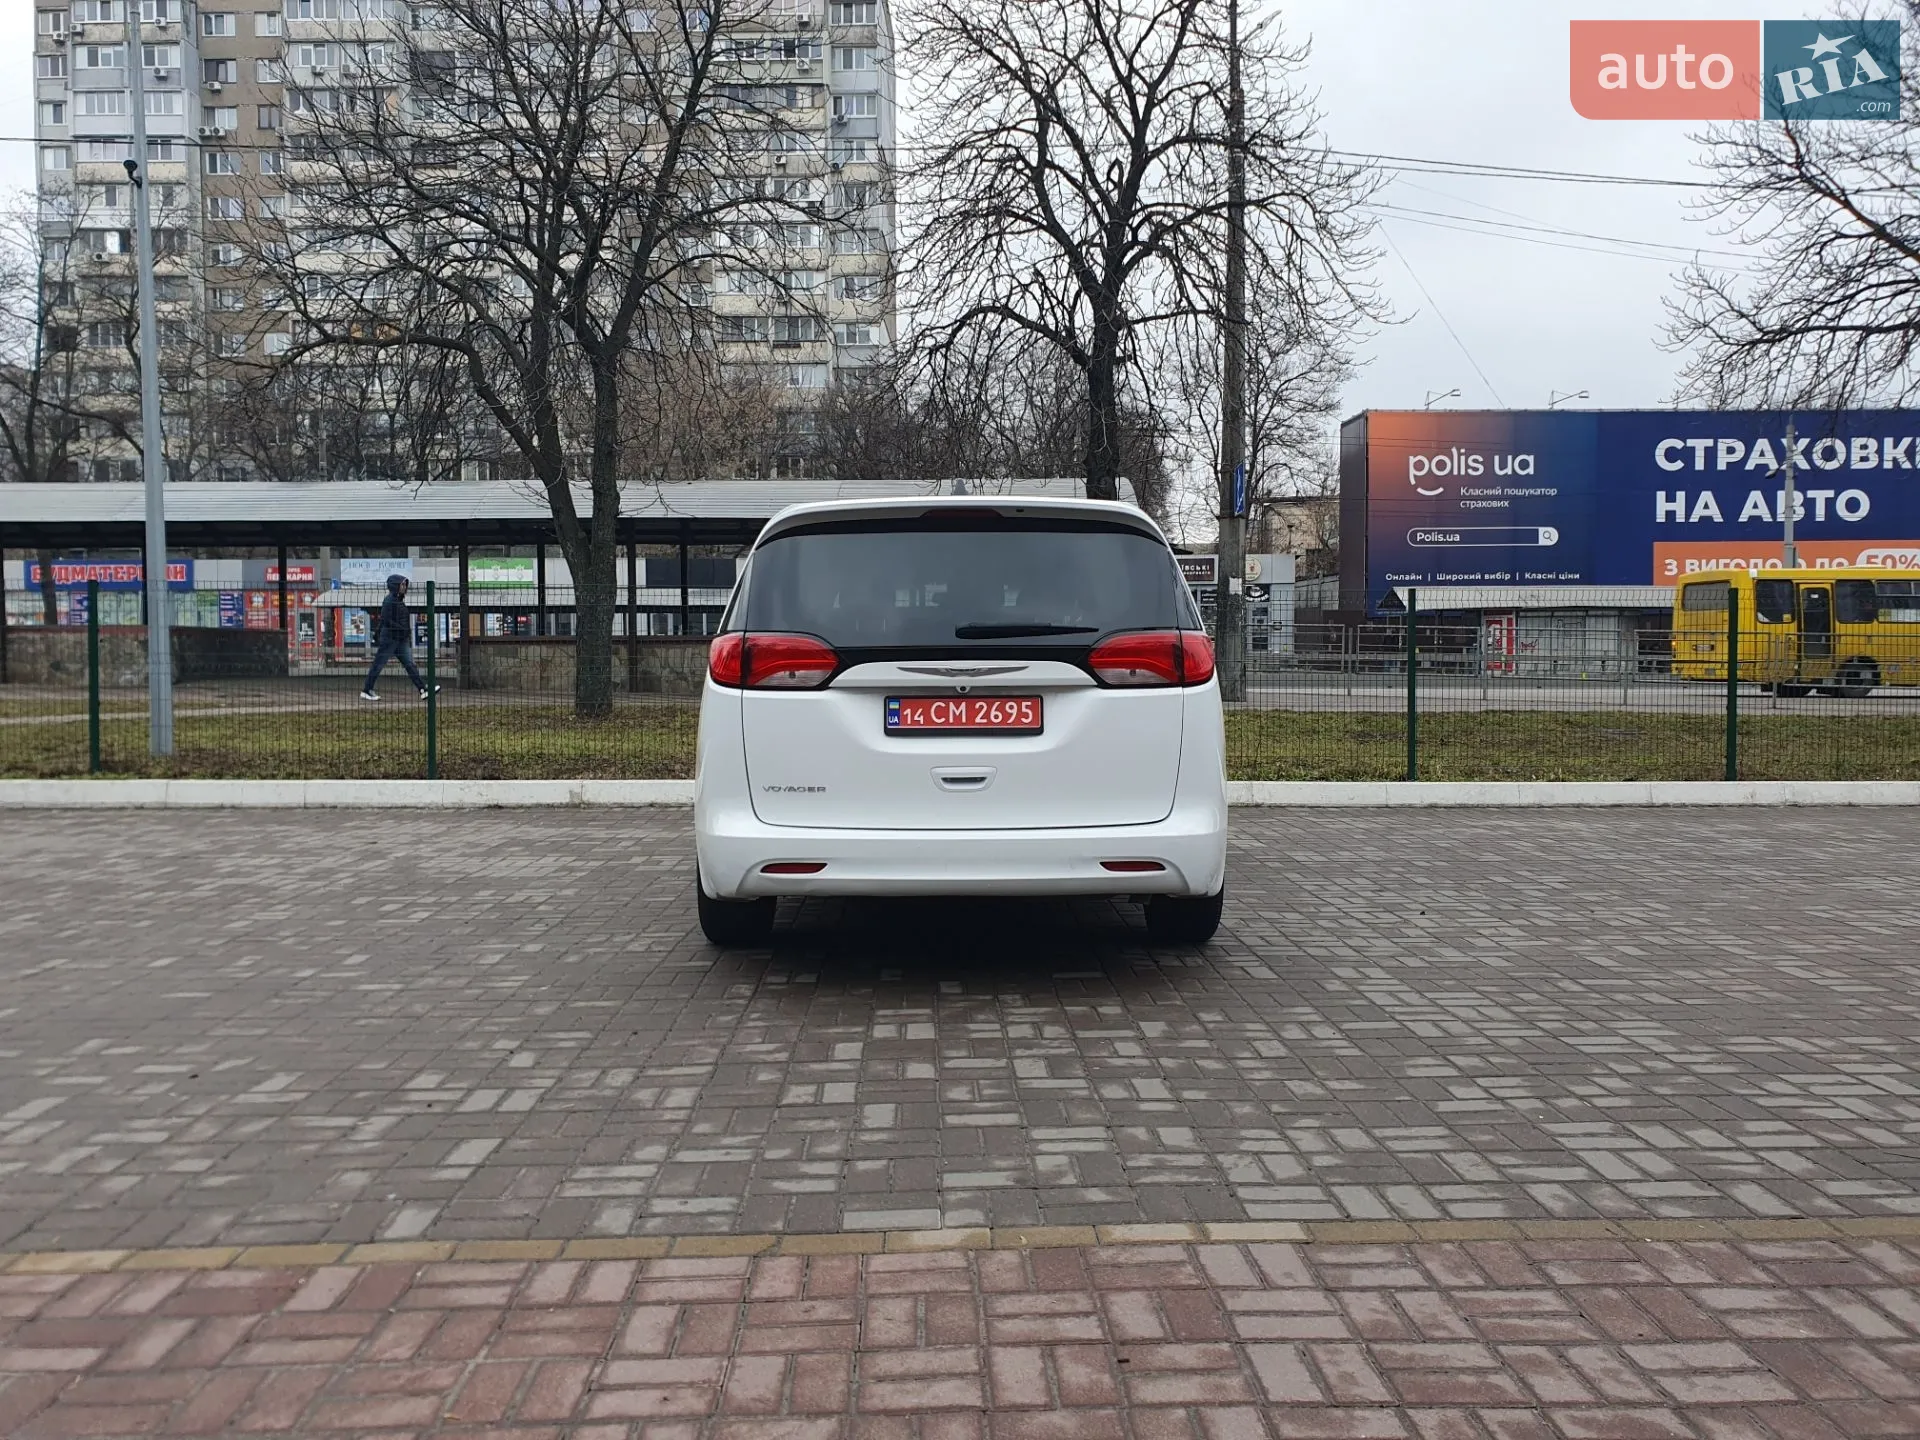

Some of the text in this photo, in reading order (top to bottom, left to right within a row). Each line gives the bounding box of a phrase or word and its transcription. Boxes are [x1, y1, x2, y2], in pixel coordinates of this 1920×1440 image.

[1655, 437, 1920, 471] СТРАХОВК
[1408, 446, 1535, 485] polis ua
[1460, 486, 1557, 497] Класний пошукатор
[1460, 499, 1510, 509] страхових
[1655, 489, 1870, 523] НА АВТО
[1416, 532, 1460, 542] Polis.ua
[1685, 558, 1807, 573] ВИГОДО
[1385, 571, 1580, 581] Онлайн Широкий вибір Класні ціни
[902, 701, 1034, 725] 14 CM 2695
[888, 715, 899, 724] UA
[761, 785, 827, 793] VOYAGER
